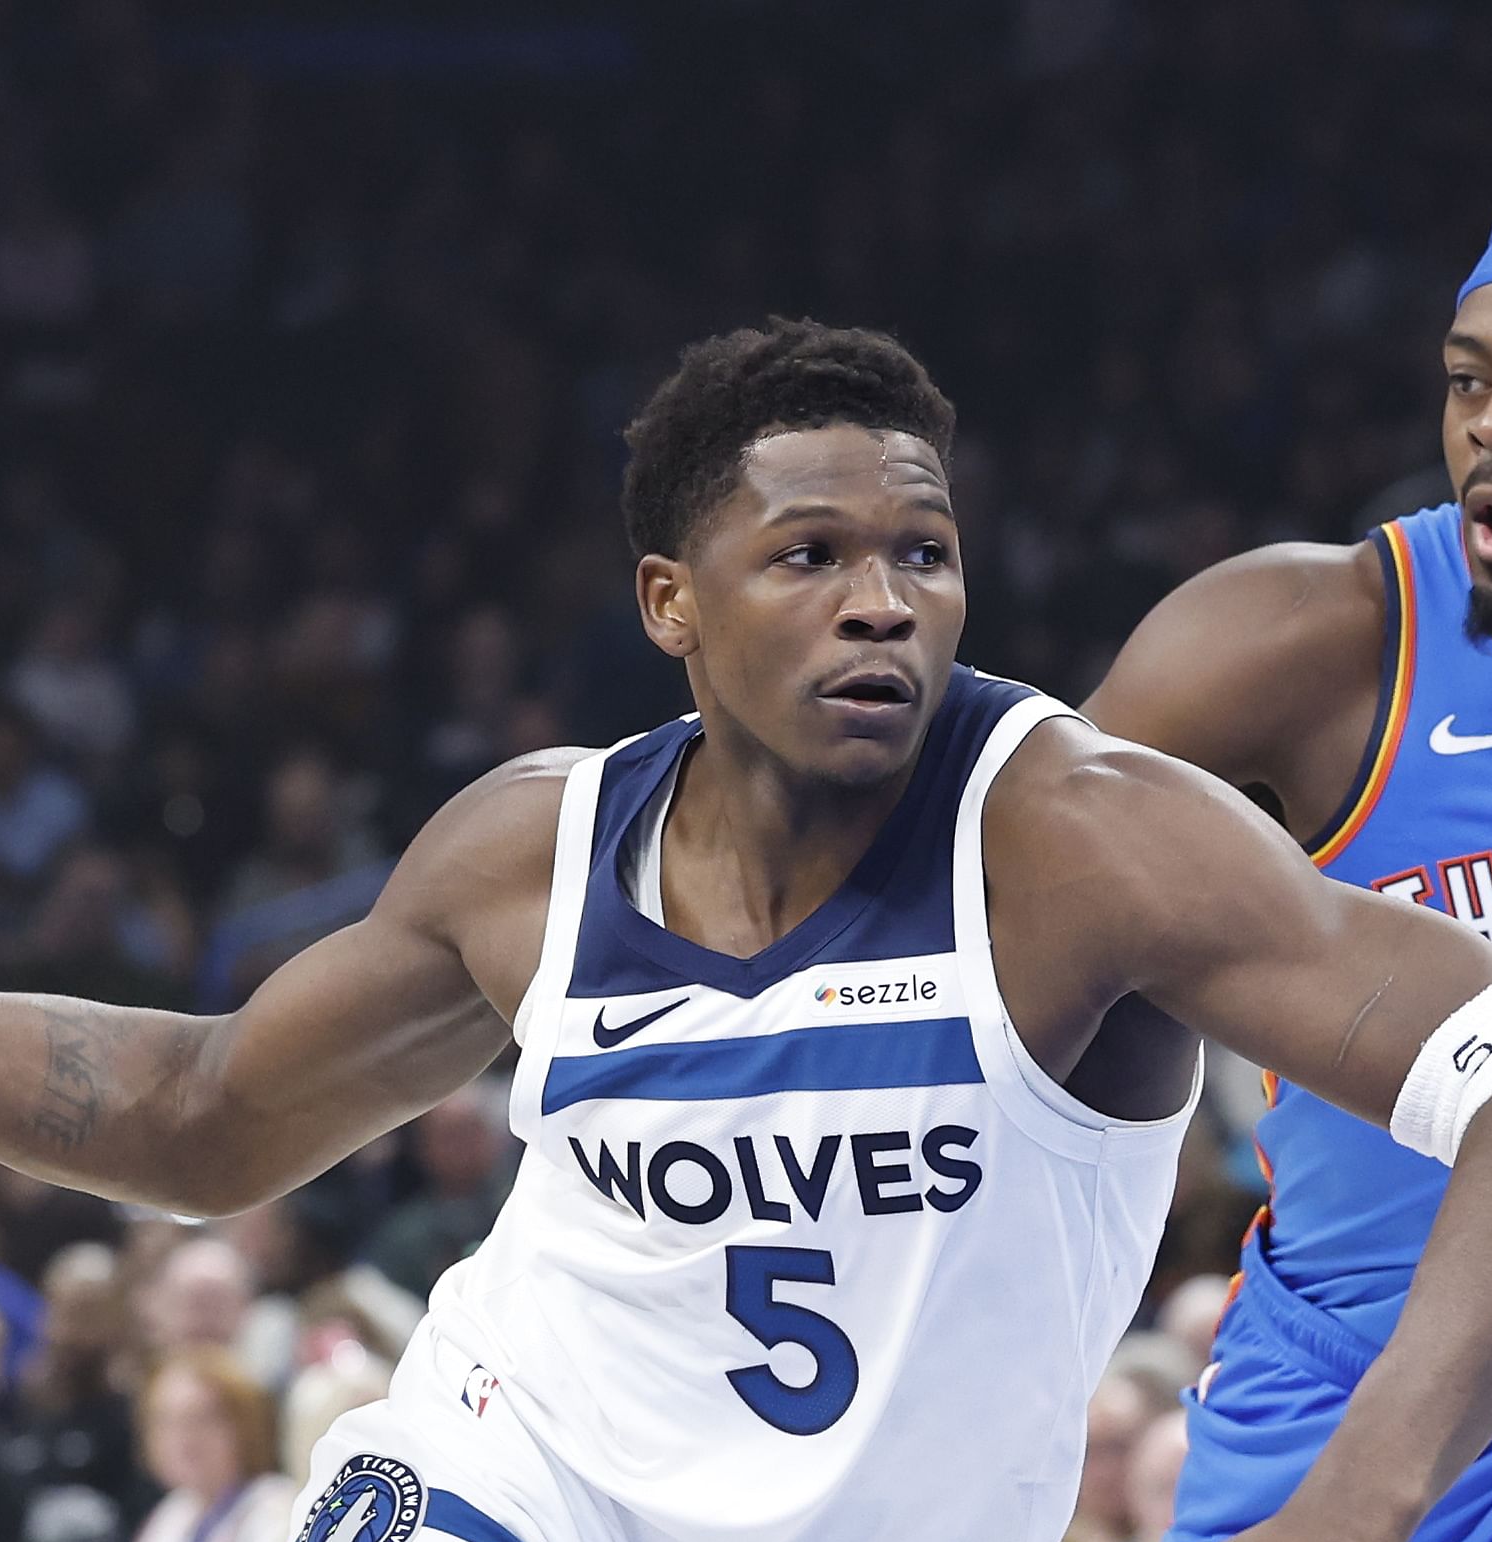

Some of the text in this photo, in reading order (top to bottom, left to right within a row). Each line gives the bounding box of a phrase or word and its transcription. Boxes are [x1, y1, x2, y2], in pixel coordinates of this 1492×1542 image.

[839, 974, 937, 1006] sezzle
[568, 1124, 984, 1226] WOLVES
[724, 1244, 859, 1437] 5
